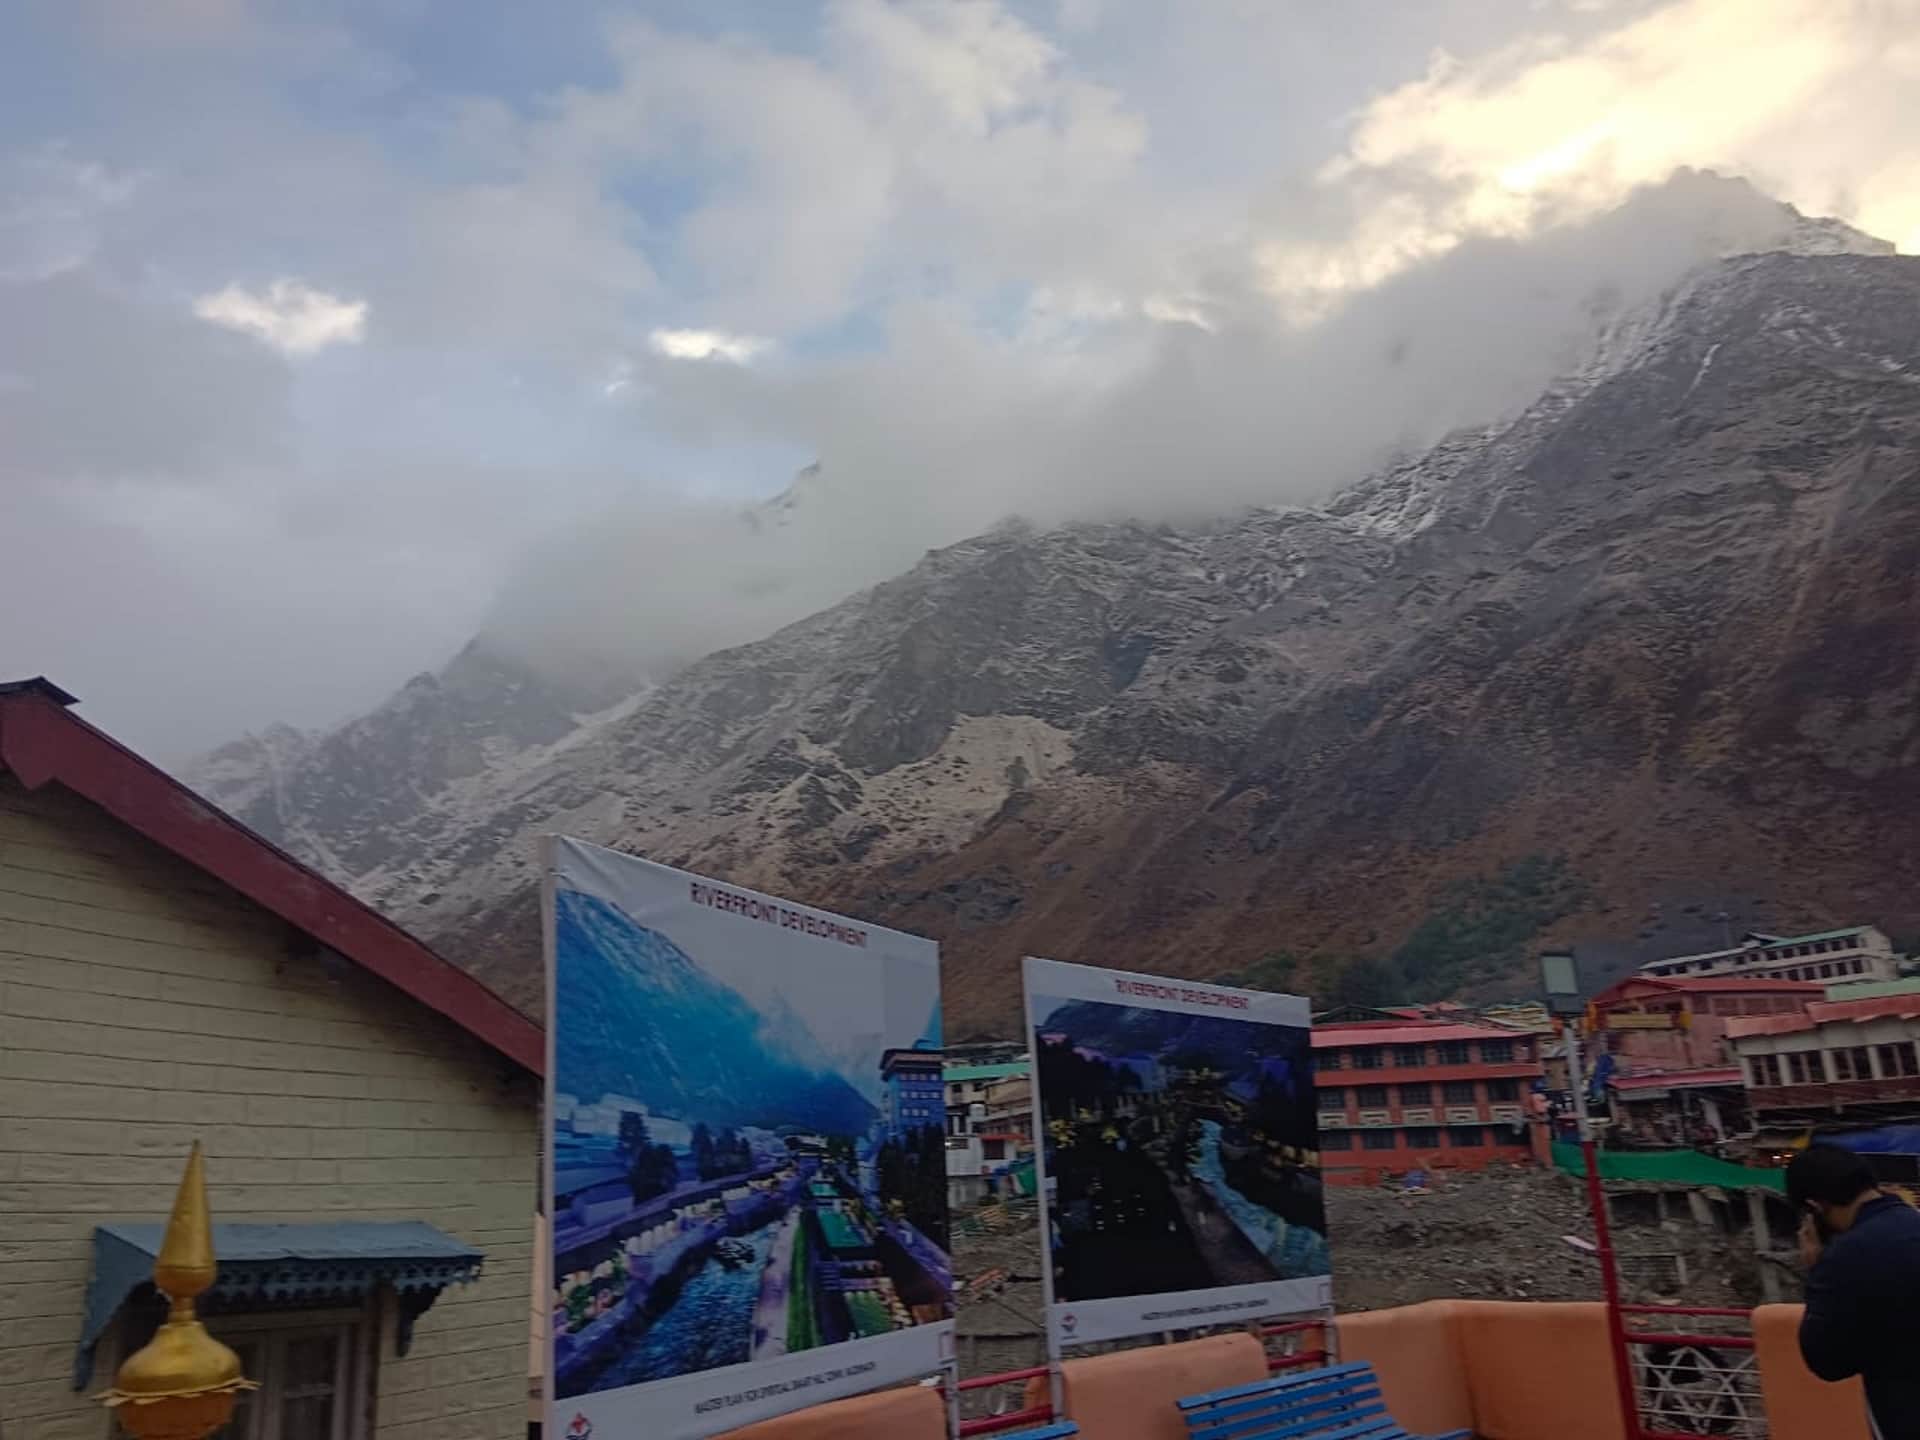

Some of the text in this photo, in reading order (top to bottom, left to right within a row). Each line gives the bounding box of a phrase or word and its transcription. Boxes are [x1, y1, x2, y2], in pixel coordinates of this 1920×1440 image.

[691, 882, 868, 949] RIVERFRONT DEVELOPMENT
[1115, 979, 1249, 1010] RIVERFRONT DEVELOPMENT
